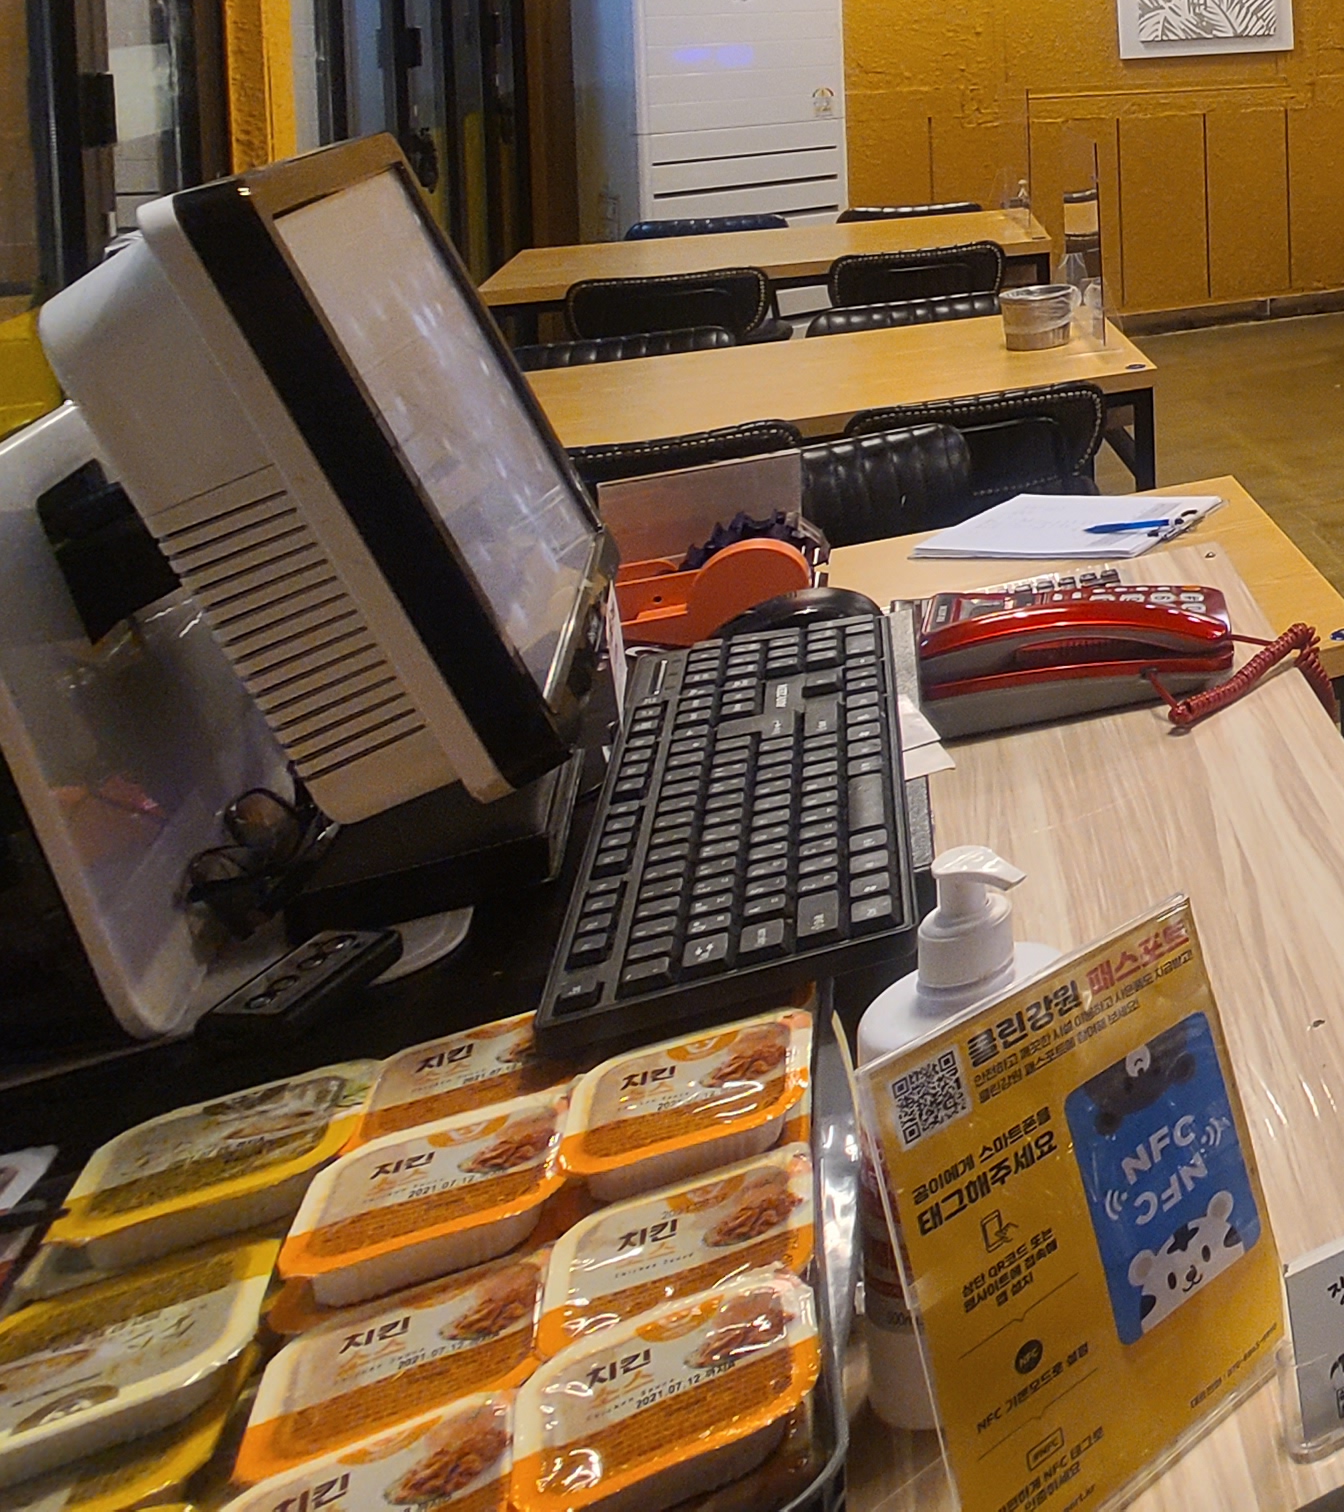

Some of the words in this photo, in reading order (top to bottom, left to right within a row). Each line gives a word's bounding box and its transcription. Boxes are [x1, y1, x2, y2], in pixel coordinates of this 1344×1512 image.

[967, 980, 1082, 1068] 클린강원
[1085, 921, 1189, 995] 패스포트
[415, 1043, 475, 1074] 치킨
[620, 1065, 676, 1091] 치킨
[369, 1151, 435, 1180] 치킨
[912, 1155, 975, 1206] 곰이에게
[978, 1106, 1052, 1165] 스마트폰을
[1121, 1114, 1196, 1185] NFC
[916, 1130, 1058, 1236] 태그해주세요
[1134, 1152, 1208, 1225] NFC
[616, 1218, 679, 1252] 치킨
[339, 1316, 411, 1355] 치킨
[586, 1348, 651, 1389] 치킨
[977, 1406, 1002, 1435] NFC
[1043, 1457, 1068, 1486] NFC
[272, 1472, 351, 1512] 치킨
